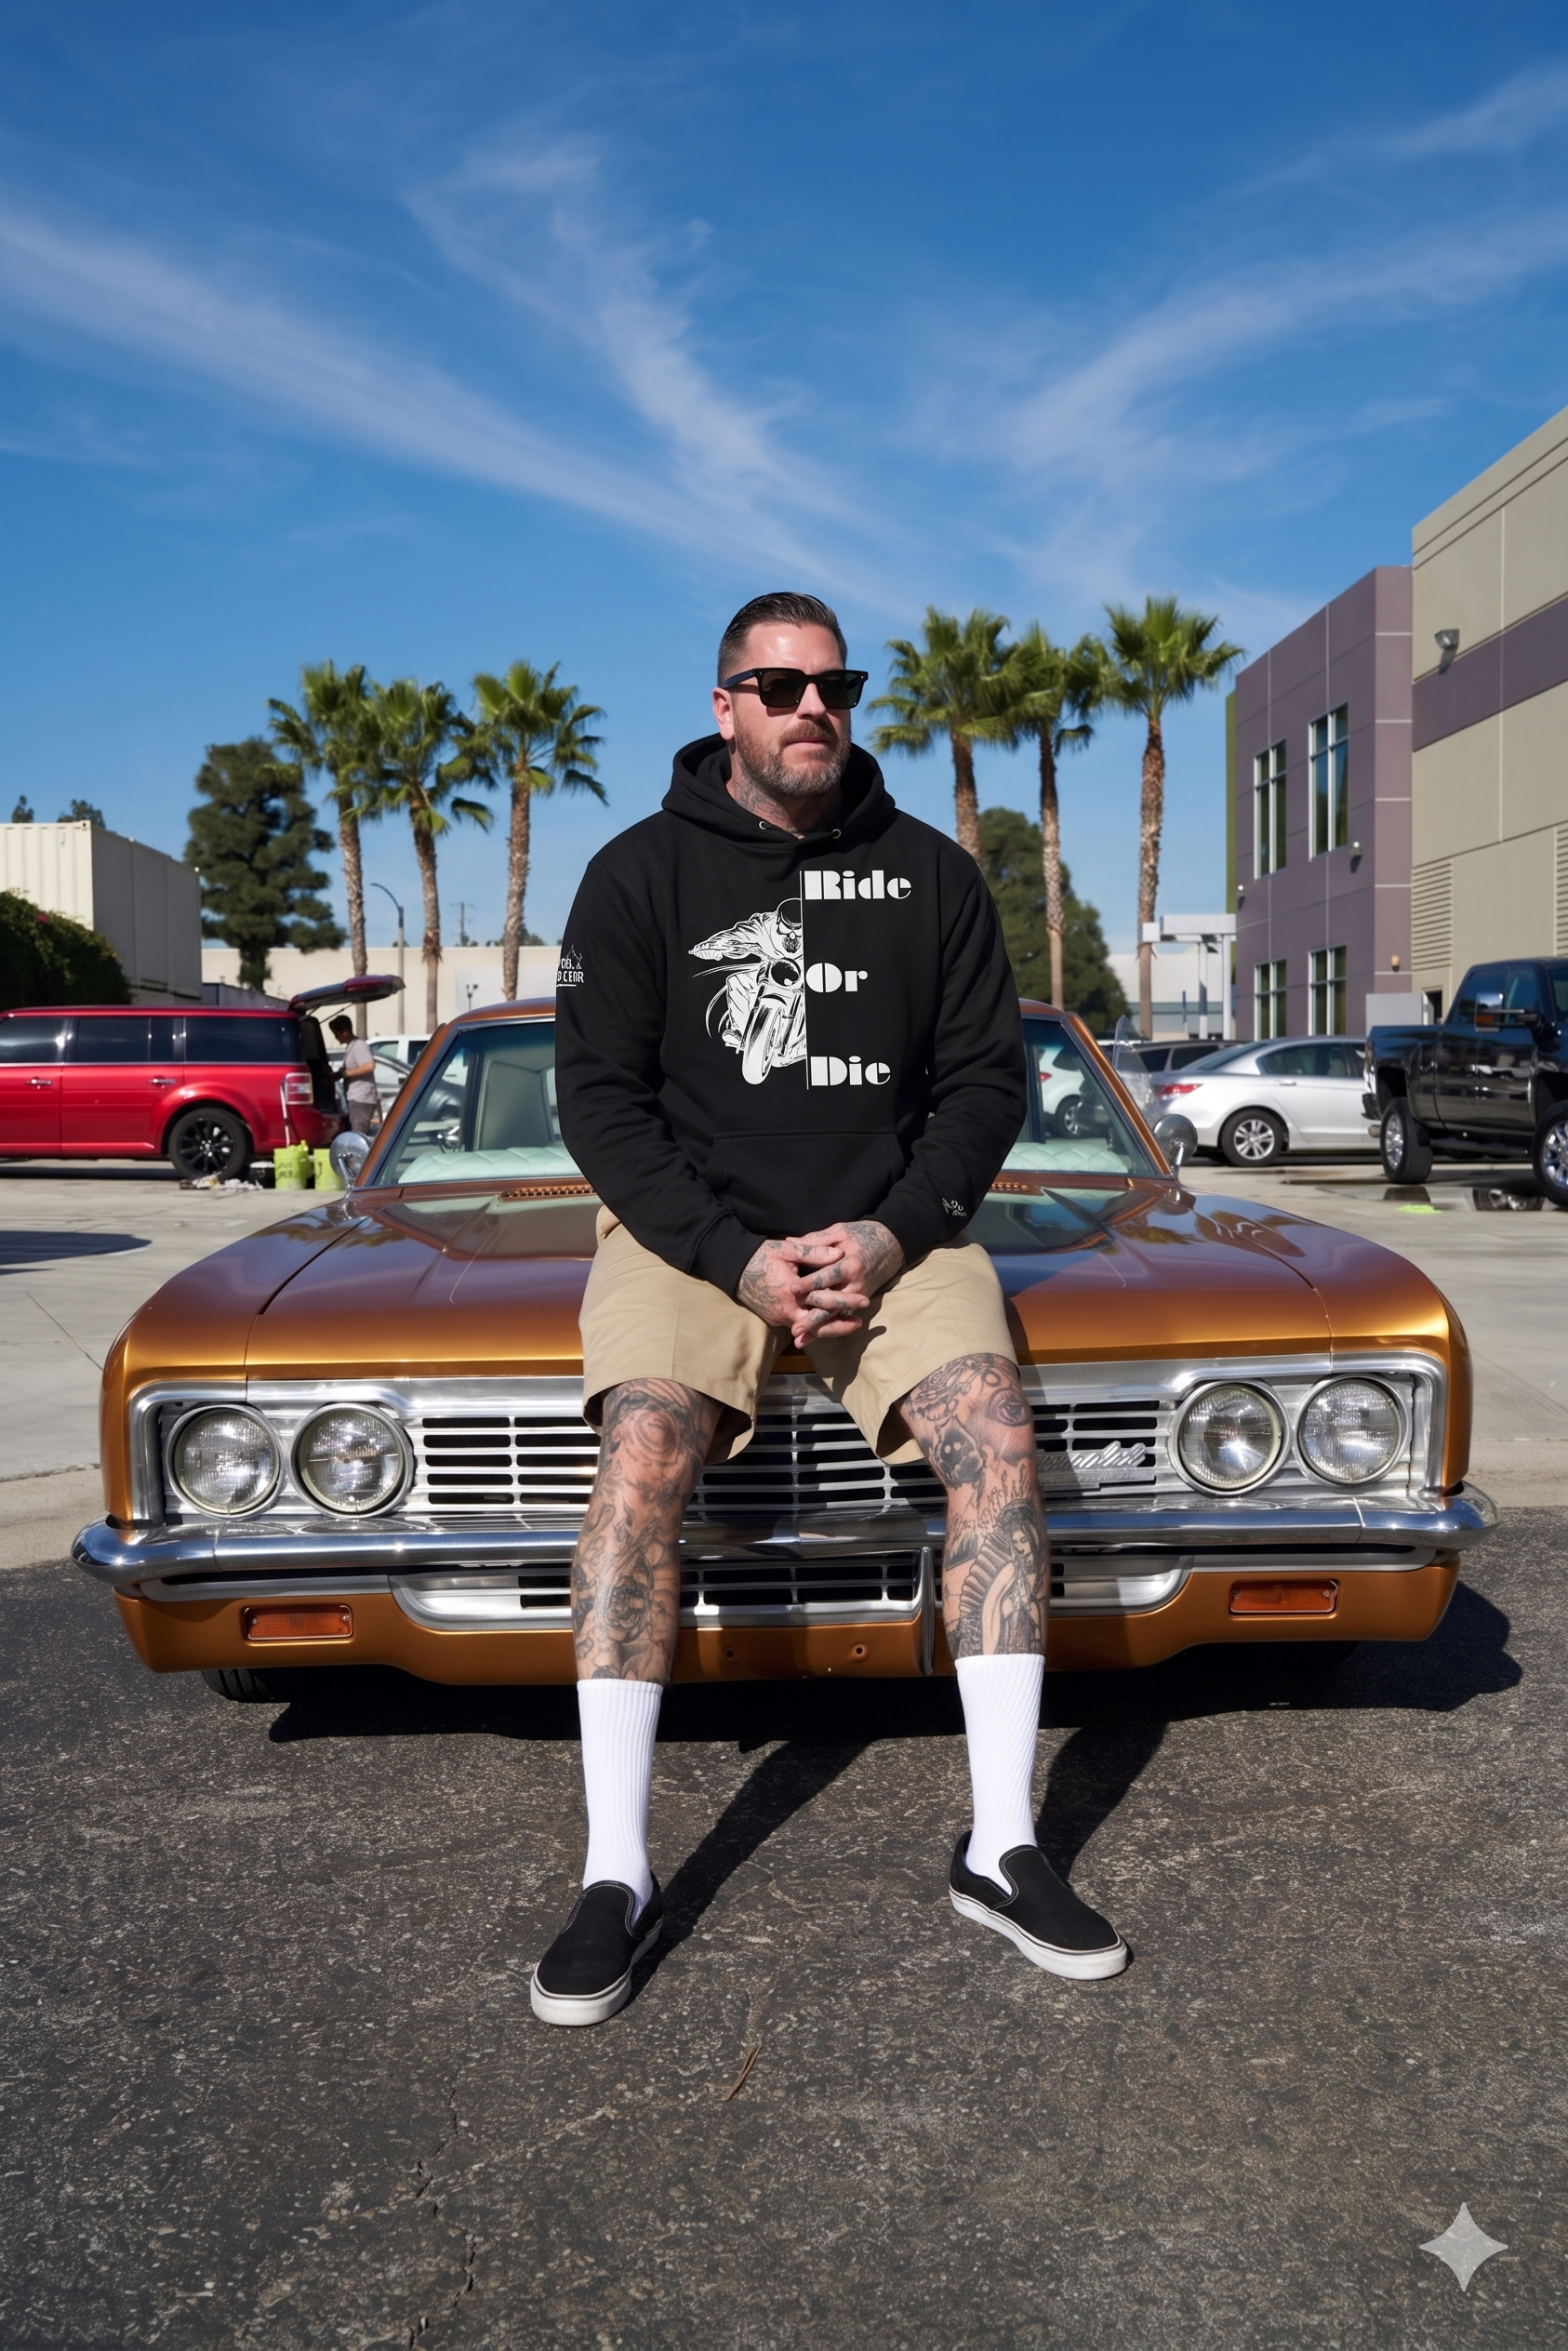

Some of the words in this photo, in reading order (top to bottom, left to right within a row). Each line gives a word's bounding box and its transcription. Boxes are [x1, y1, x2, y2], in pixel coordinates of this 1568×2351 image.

[804, 870, 912, 900] Ride
[805, 963, 869, 993] Or
[810, 1056, 891, 1086] Die
